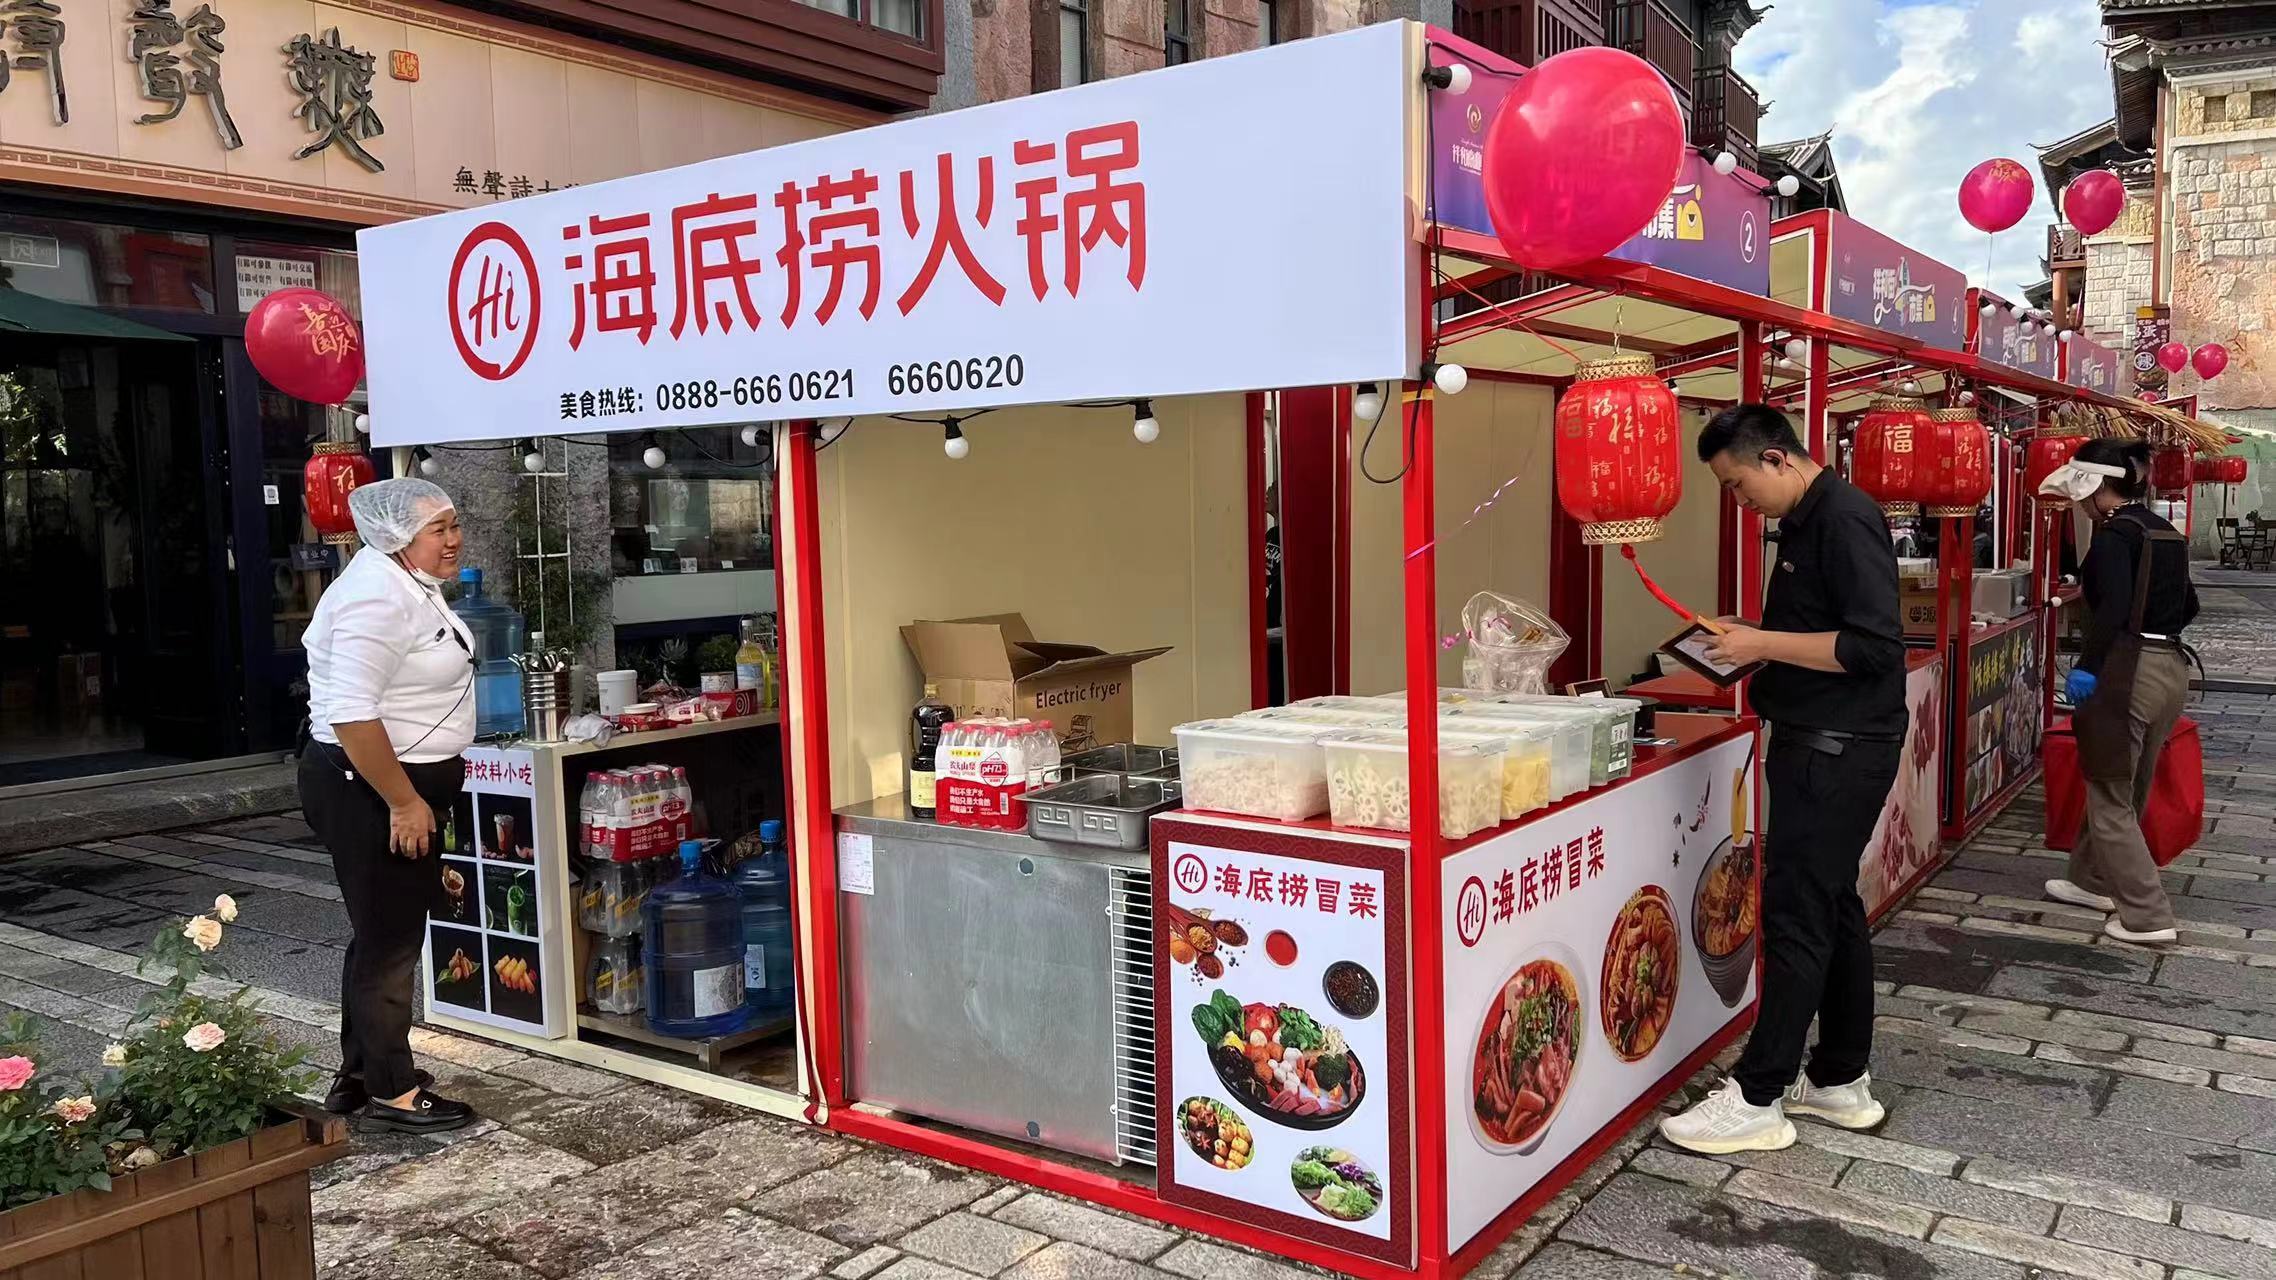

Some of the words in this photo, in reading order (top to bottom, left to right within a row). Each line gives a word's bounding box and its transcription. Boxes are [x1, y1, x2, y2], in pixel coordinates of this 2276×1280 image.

[562, 120, 1148, 352] 海底捞火锅
[888, 354, 1024, 395] 6660620
[1885, 424, 1913, 453] 福
[1036, 685, 1086, 709] Electric
[1090, 682, 1121, 701] fryer
[1214, 863, 1378, 919] 海底捞冒菜
[1492, 826, 1605, 925] 海底捞冒菜
